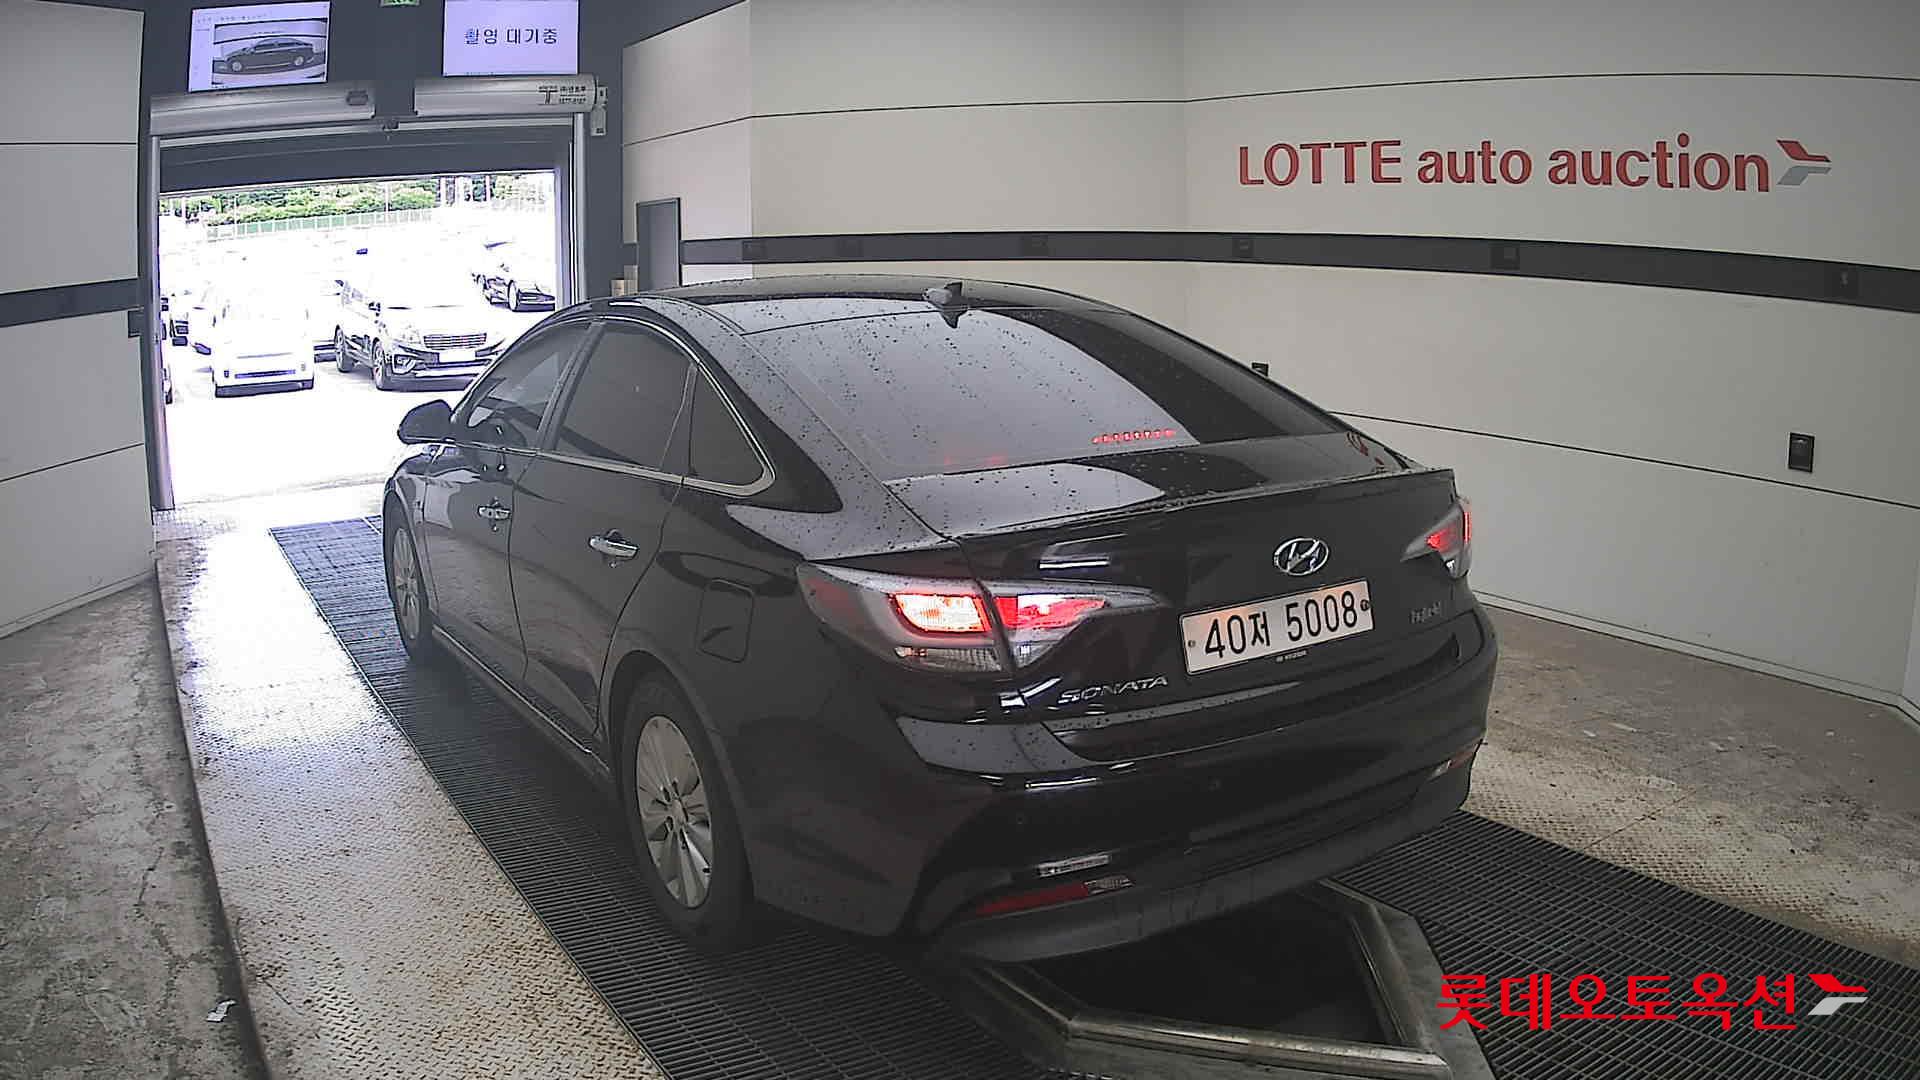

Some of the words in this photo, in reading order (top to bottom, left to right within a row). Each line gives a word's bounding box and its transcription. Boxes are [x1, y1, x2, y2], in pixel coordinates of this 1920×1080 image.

[506, 28, 558, 45] 대기중
[1239, 139, 1403, 187] LOTTE
[1417, 140, 1533, 186] auto
[1548, 133, 1770, 193] auction
[1204, 611, 1271, 658] 40저
[1285, 590, 1358, 642] 5008
[1057, 675, 1169, 704] SONATA
